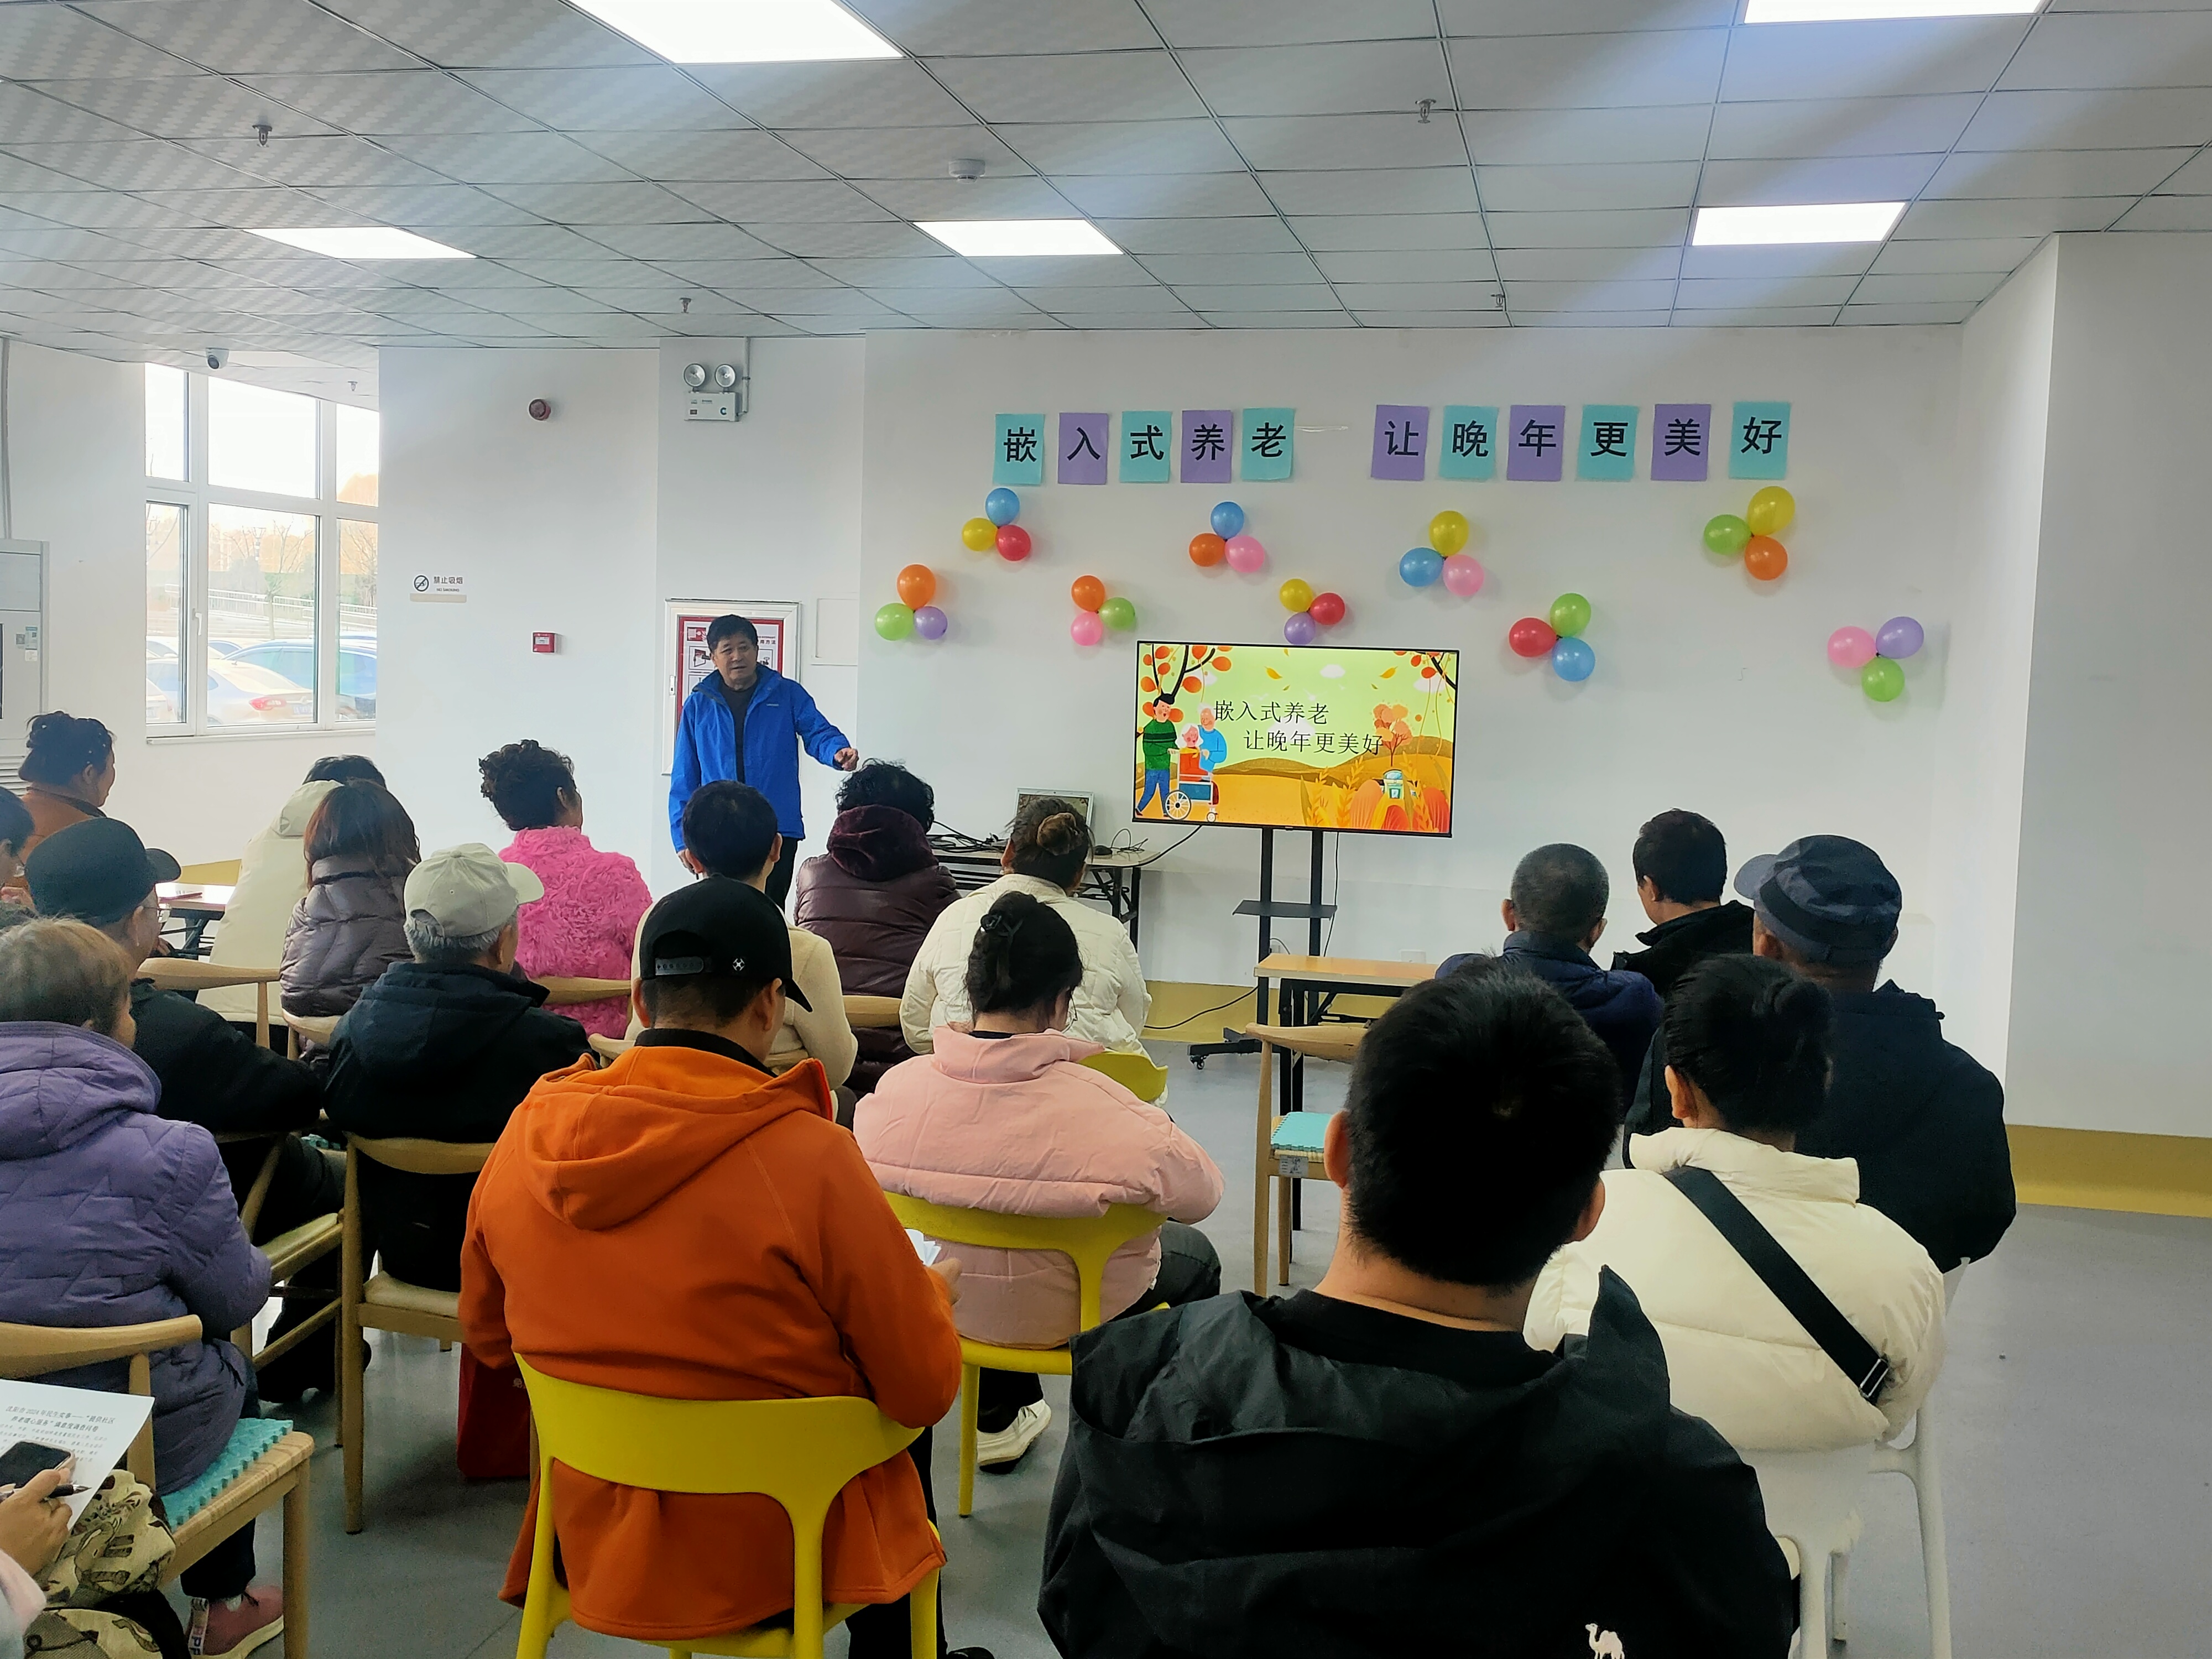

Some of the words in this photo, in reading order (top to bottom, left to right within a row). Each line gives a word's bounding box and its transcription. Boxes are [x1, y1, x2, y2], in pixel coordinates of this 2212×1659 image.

[1003, 422, 1286, 462] 嵌入式养老
[1384, 416, 1782, 457] 让晚年更美好
[1214, 700, 1329, 724] 嵌入式养老
[1243, 729, 1384, 755] 让晚年更美好
